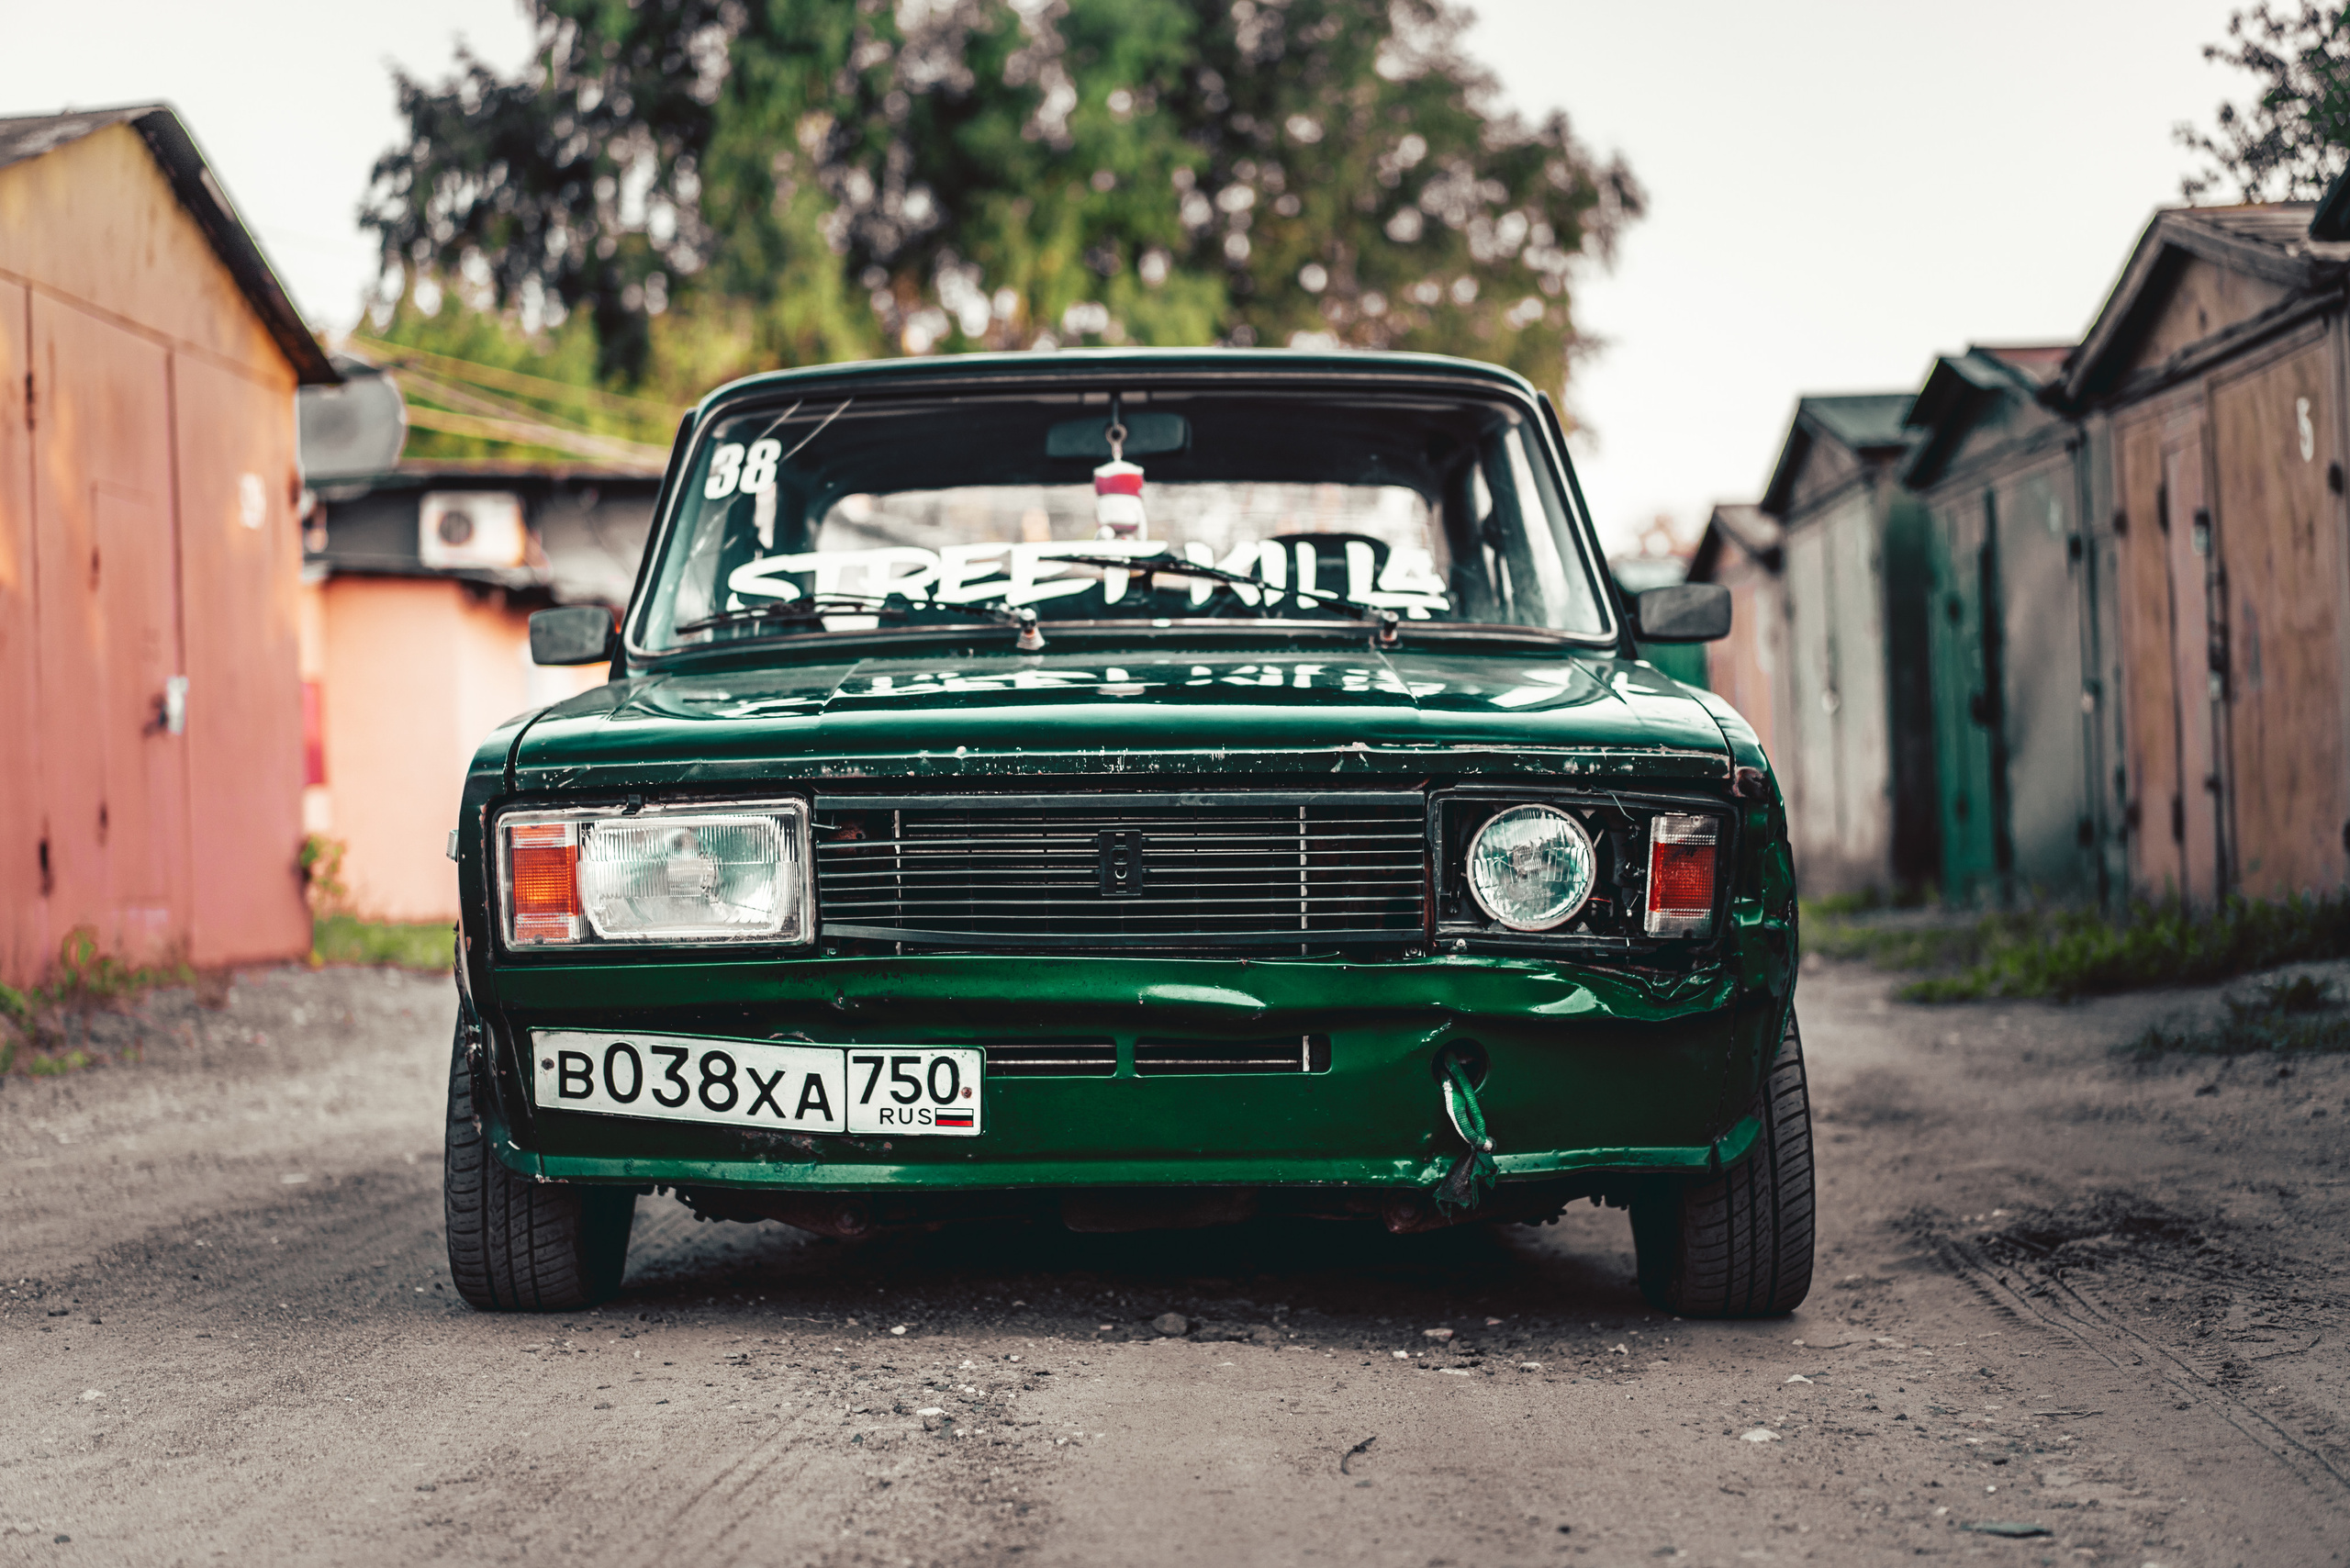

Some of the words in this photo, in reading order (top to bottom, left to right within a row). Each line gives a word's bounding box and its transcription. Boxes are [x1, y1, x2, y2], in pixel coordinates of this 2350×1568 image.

[703, 438, 782, 500] 38
[726, 539, 1169, 610] STREET
[852, 1055, 960, 1105] 750
[878, 1107, 933, 1126] RUS
